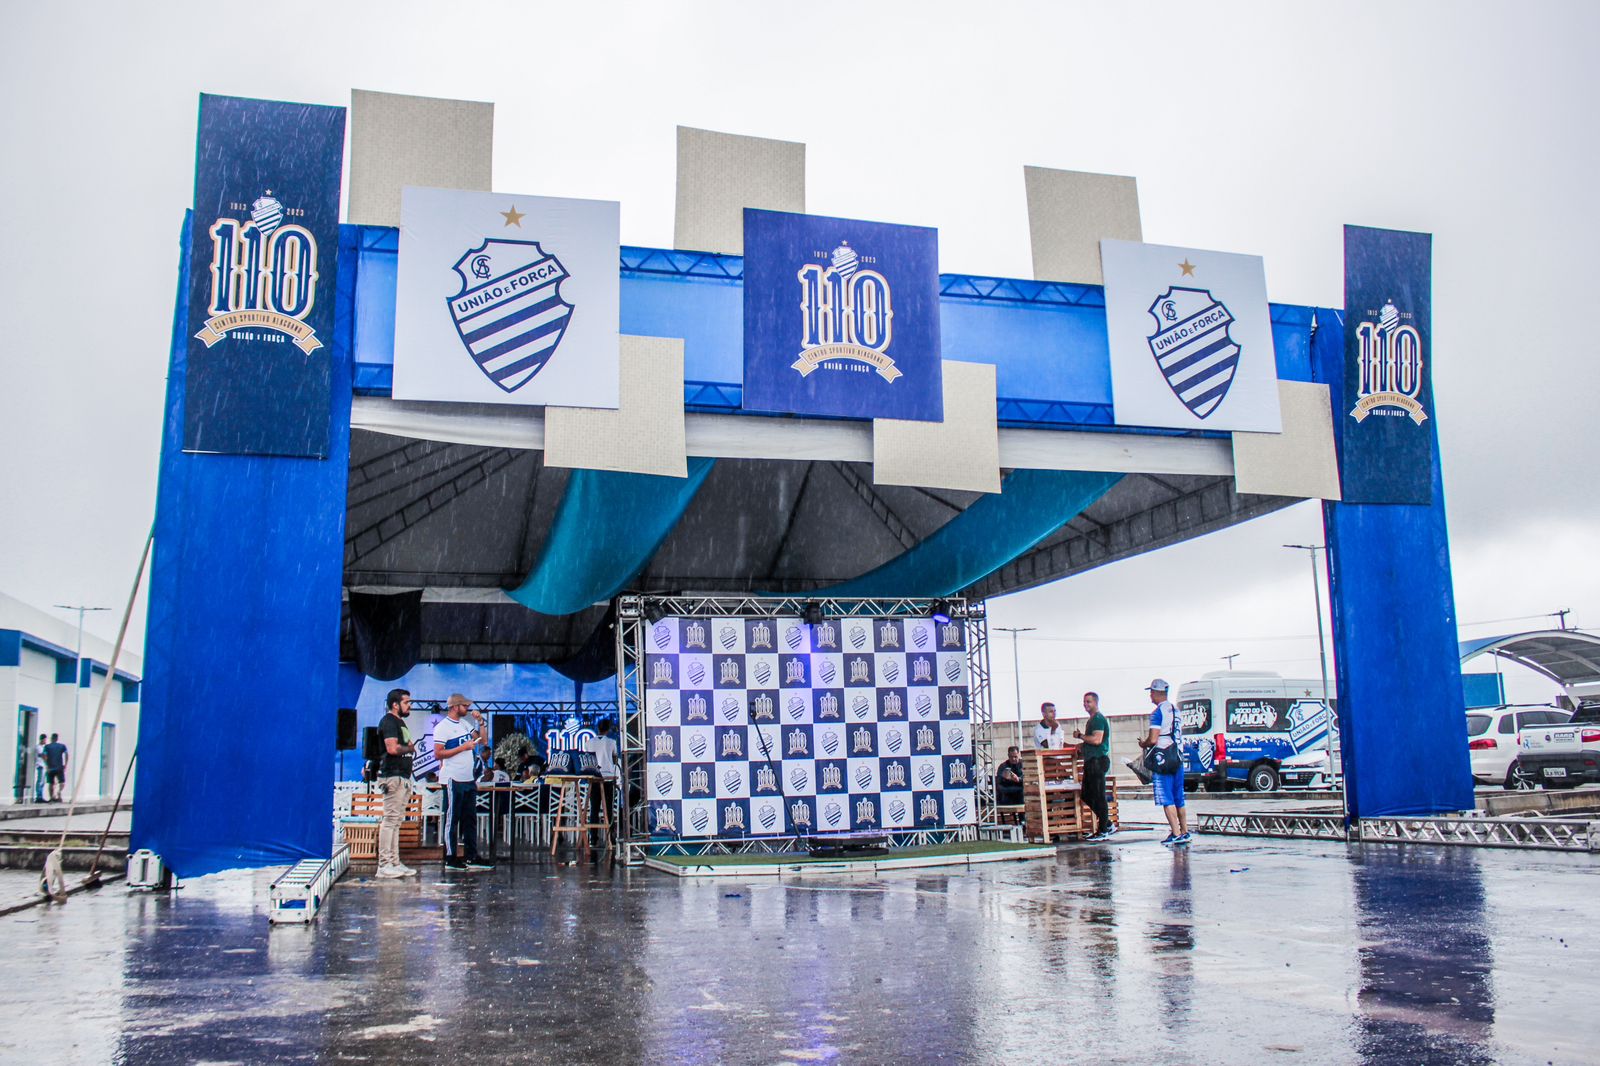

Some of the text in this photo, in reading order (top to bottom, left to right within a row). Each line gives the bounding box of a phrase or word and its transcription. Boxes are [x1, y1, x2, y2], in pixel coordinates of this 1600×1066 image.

[208, 218, 319, 321] 110
[457, 264, 558, 313] UNIÃO E FORÇA
[213, 313, 303, 334] CENTRO SPORTIVO ALAGOANO
[797, 264, 894, 352] 110
[1155, 309, 1226, 350] UNIÃO E FORÇA
[807, 347, 828, 361] CENTRO
[1356, 322, 1423, 400] 110
[1229, 713, 1267, 725] MAIOR
